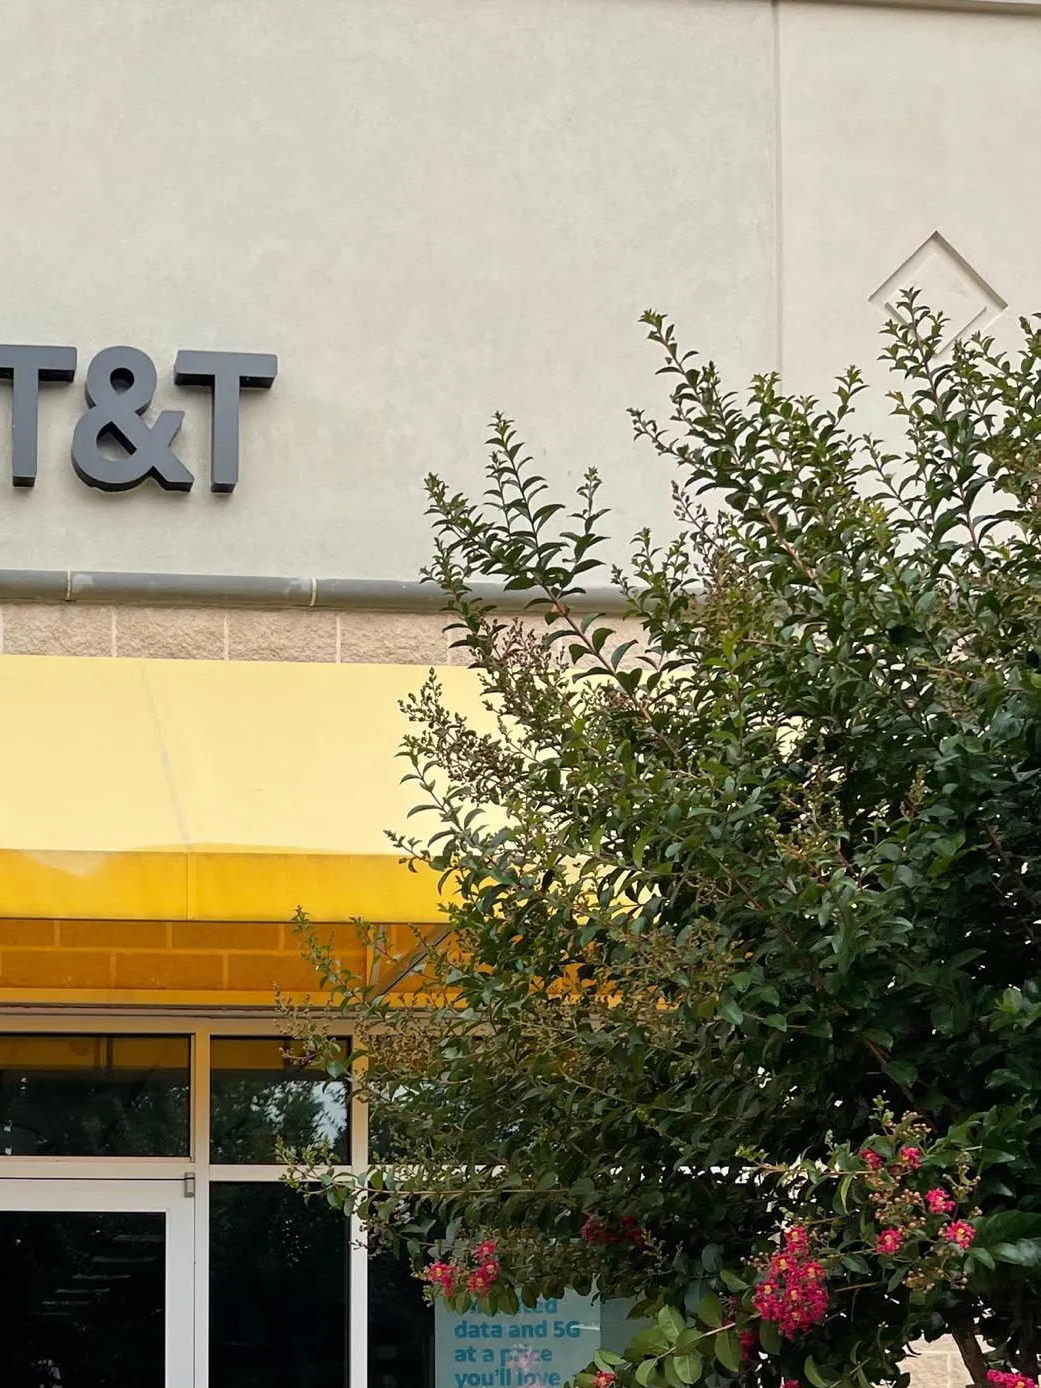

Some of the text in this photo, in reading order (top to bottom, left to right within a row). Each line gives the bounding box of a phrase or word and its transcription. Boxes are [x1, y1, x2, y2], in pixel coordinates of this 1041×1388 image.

[454, 1320, 581, 1338] data and 5G
[454, 1347, 476, 1362] at
[483, 1349, 494, 1362] a
